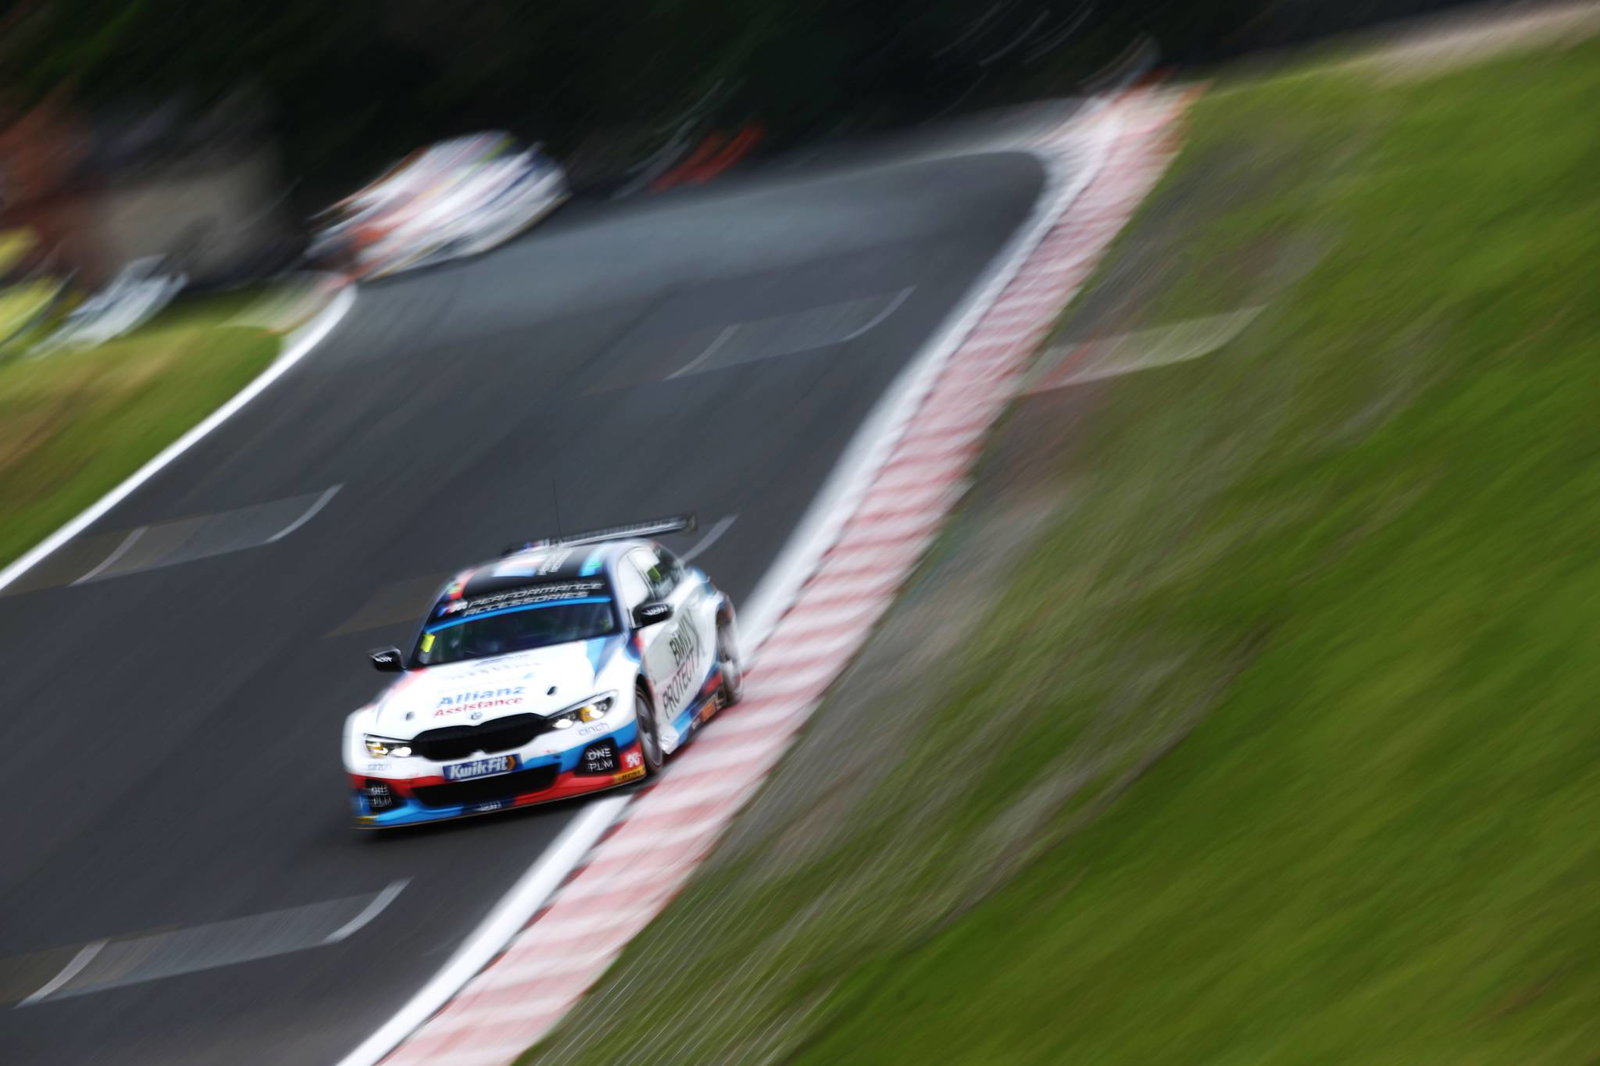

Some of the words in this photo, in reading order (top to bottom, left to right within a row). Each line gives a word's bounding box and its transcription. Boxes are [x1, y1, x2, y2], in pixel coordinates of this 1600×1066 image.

[463, 591, 589, 617] ACCESSORIES
[468, 583, 603, 608] PERFORMANCE
[662, 647, 696, 720] PROTECT
[438, 686, 525, 707] Allianz
[433, 697, 523, 718] Assistance
[587, 747, 611, 760] ONE
[588, 759, 613, 772] PLM
